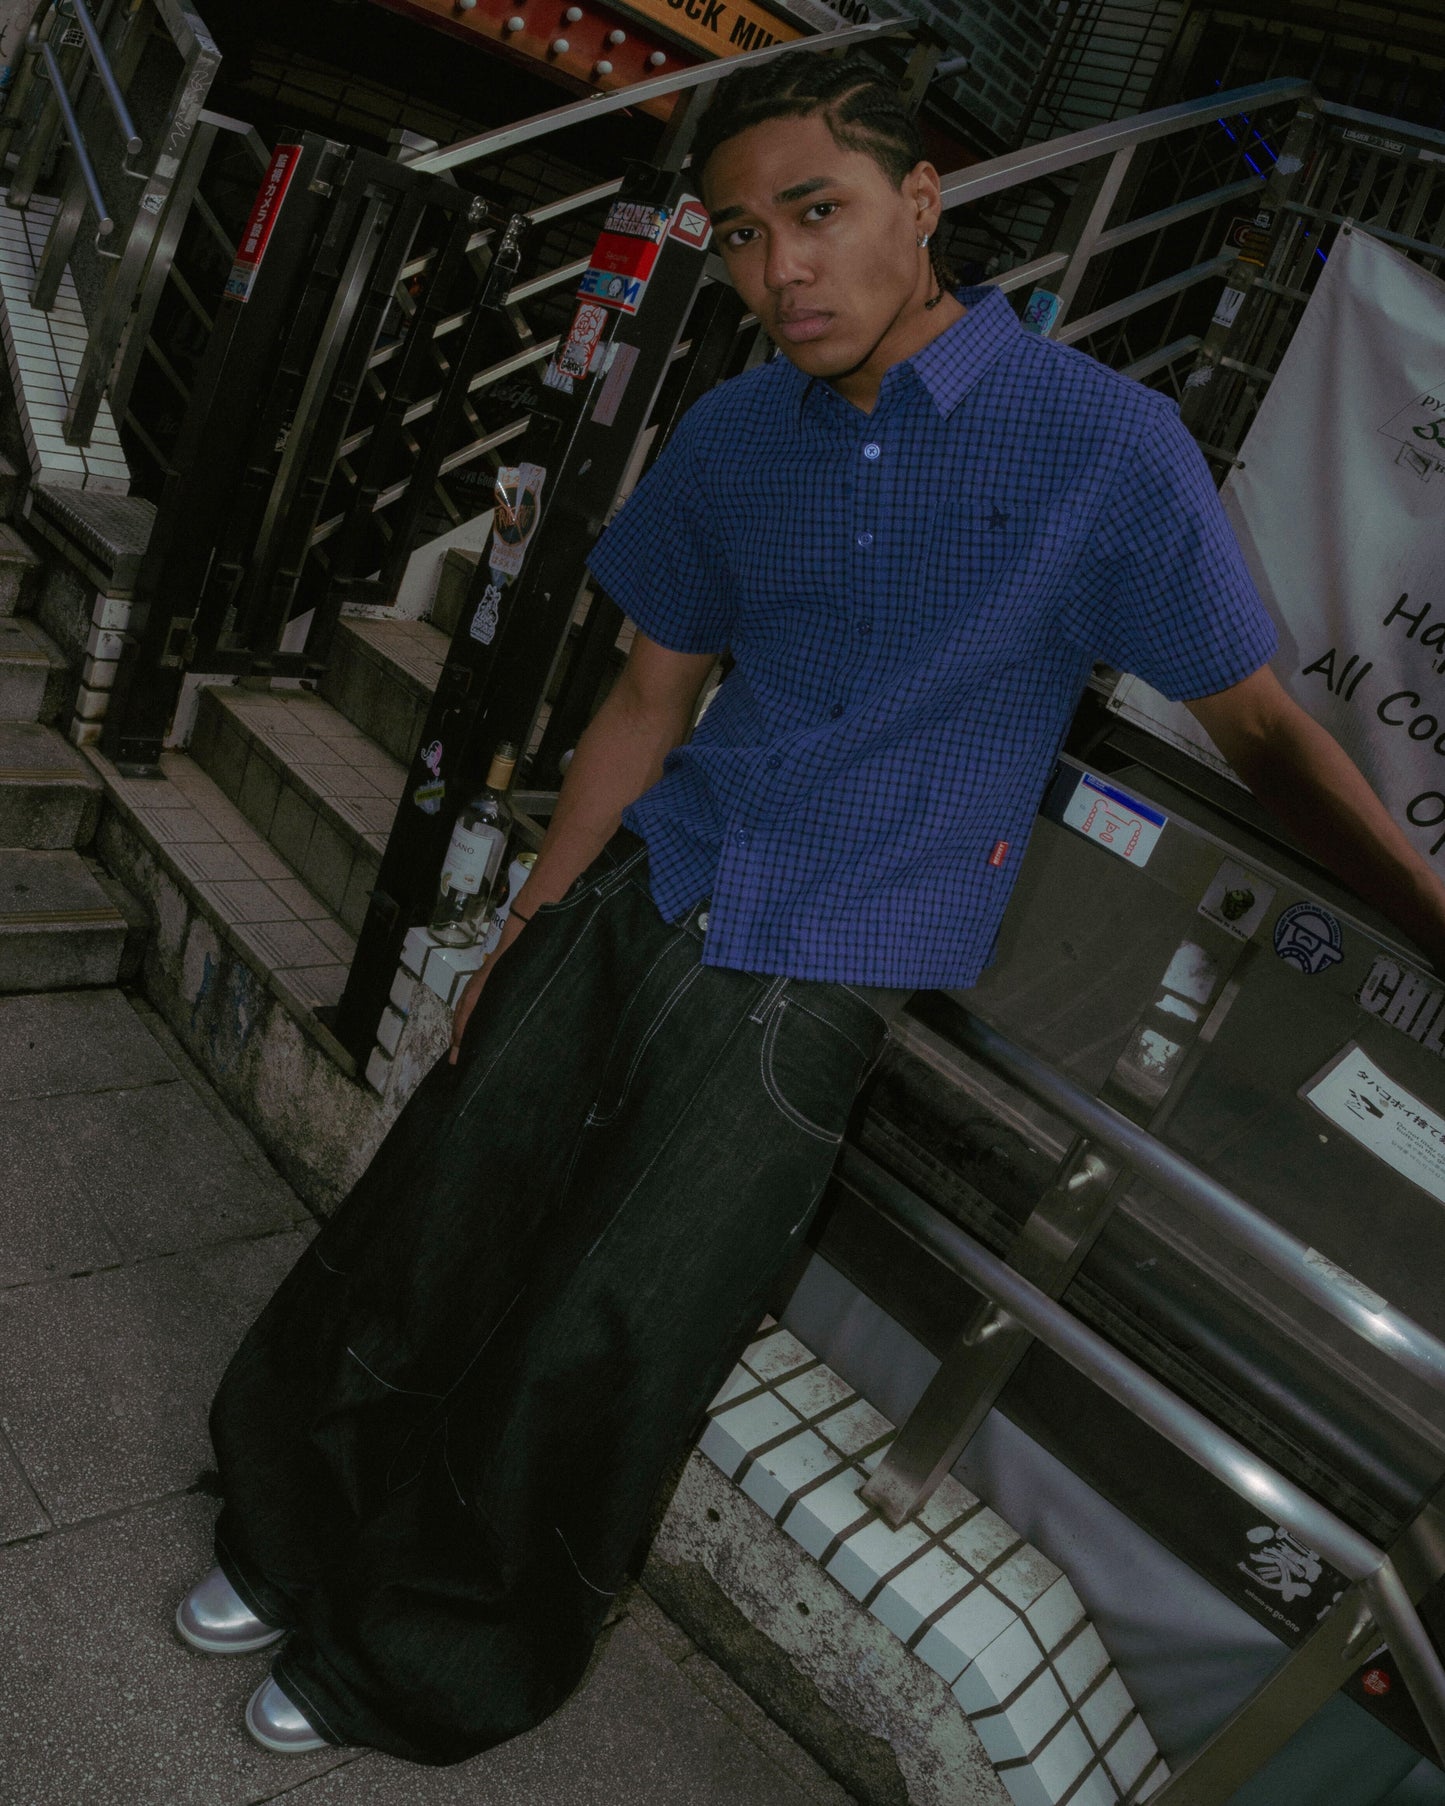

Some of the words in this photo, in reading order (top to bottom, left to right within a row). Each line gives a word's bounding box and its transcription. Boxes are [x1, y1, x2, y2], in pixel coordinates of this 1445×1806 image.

[729, 14, 784, 51] MU
[614, 201, 655, 220] ZONE
[1421, 395, 1445, 412] PY
[1383, 593, 1445, 674] Ha
[1303, 648, 1372, 702] All
[1356, 957, 1445, 1057] CHIL
